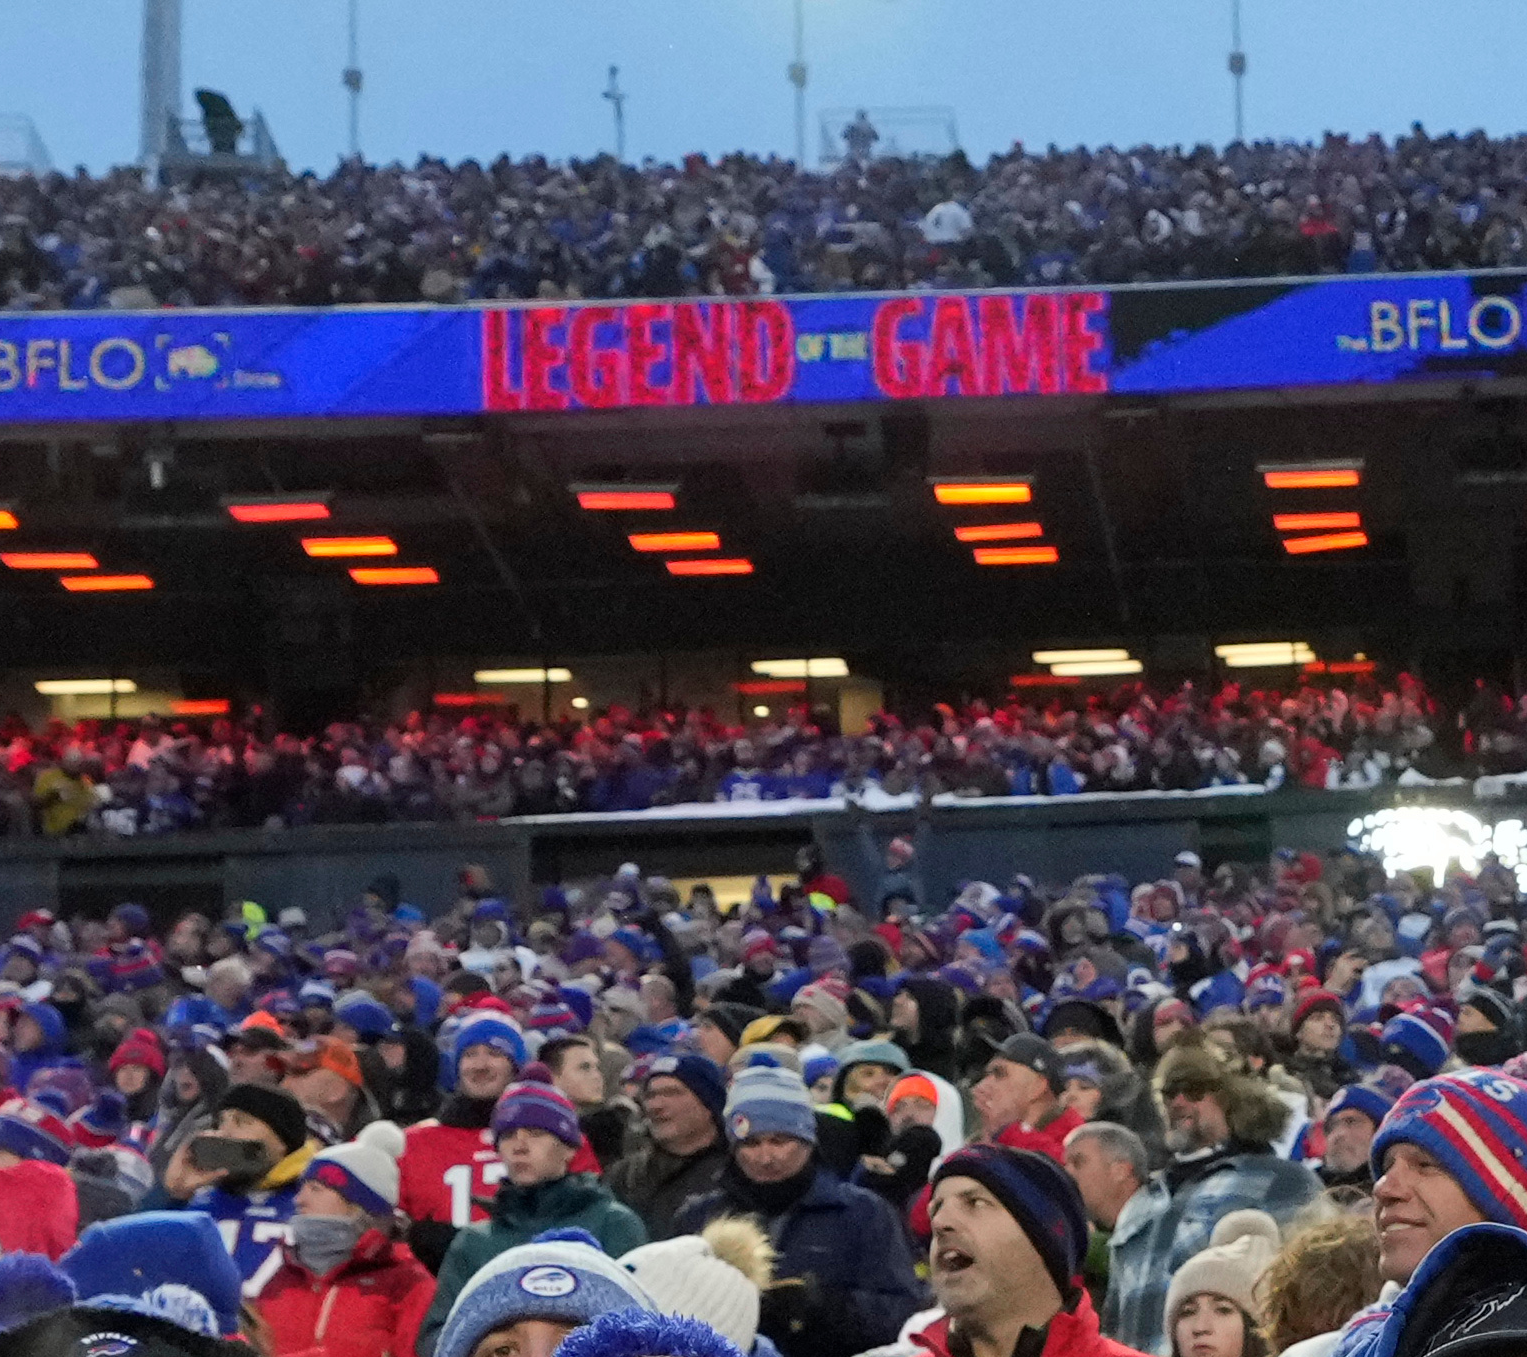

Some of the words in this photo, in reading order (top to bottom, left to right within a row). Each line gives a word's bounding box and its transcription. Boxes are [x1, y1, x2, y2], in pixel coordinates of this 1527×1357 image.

[482, 304, 794, 412] LEGEND
[874, 292, 1111, 399] GAME
[1368, 295, 1521, 352] BFLO
